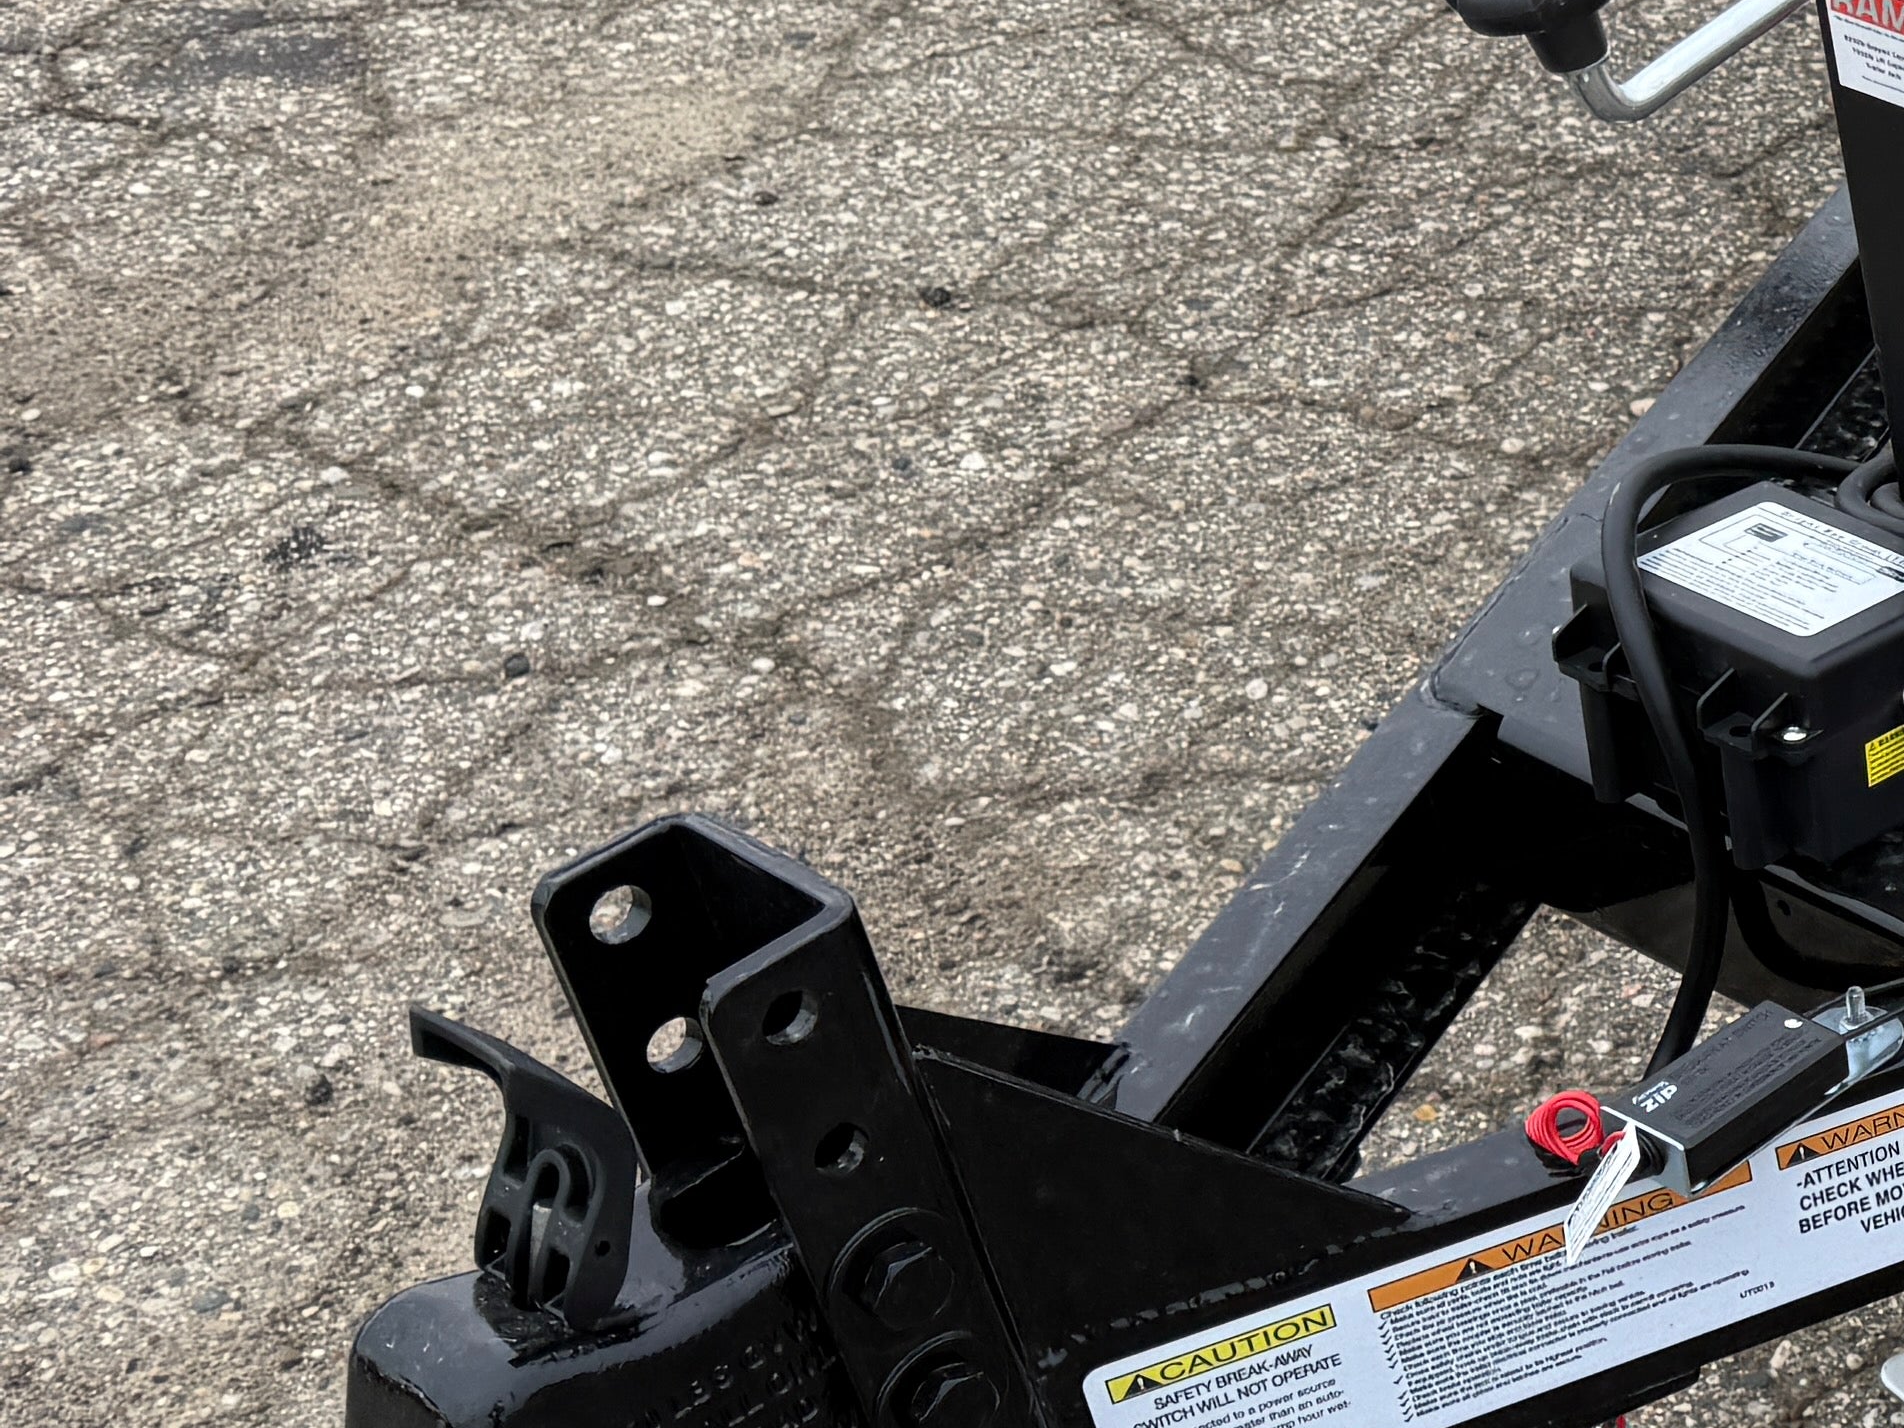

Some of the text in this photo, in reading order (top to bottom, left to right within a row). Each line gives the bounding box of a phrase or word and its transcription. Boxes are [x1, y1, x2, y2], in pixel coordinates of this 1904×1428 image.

[1799, 1177, 1861, 1211] CHECK
[1502, 1192, 1674, 1263] WAING
[1798, 1195, 1871, 1234] BEFORE
[1156, 1311, 1327, 1383] CAUTION
[1152, 1343, 1316, 1410] SAFETY BREAK-AWAY
[1195, 1391, 1235, 1414] WILL
[1235, 1378, 1270, 1400] NOT
[1270, 1353, 1342, 1387] OPERATE
[1232, 1408, 1246, 1420] to
[1257, 1392, 1295, 1413] power
[1267, 1404, 1295, 1421] than
[1297, 1399, 1312, 1410] an
[1296, 1408, 1325, 1425] hour
